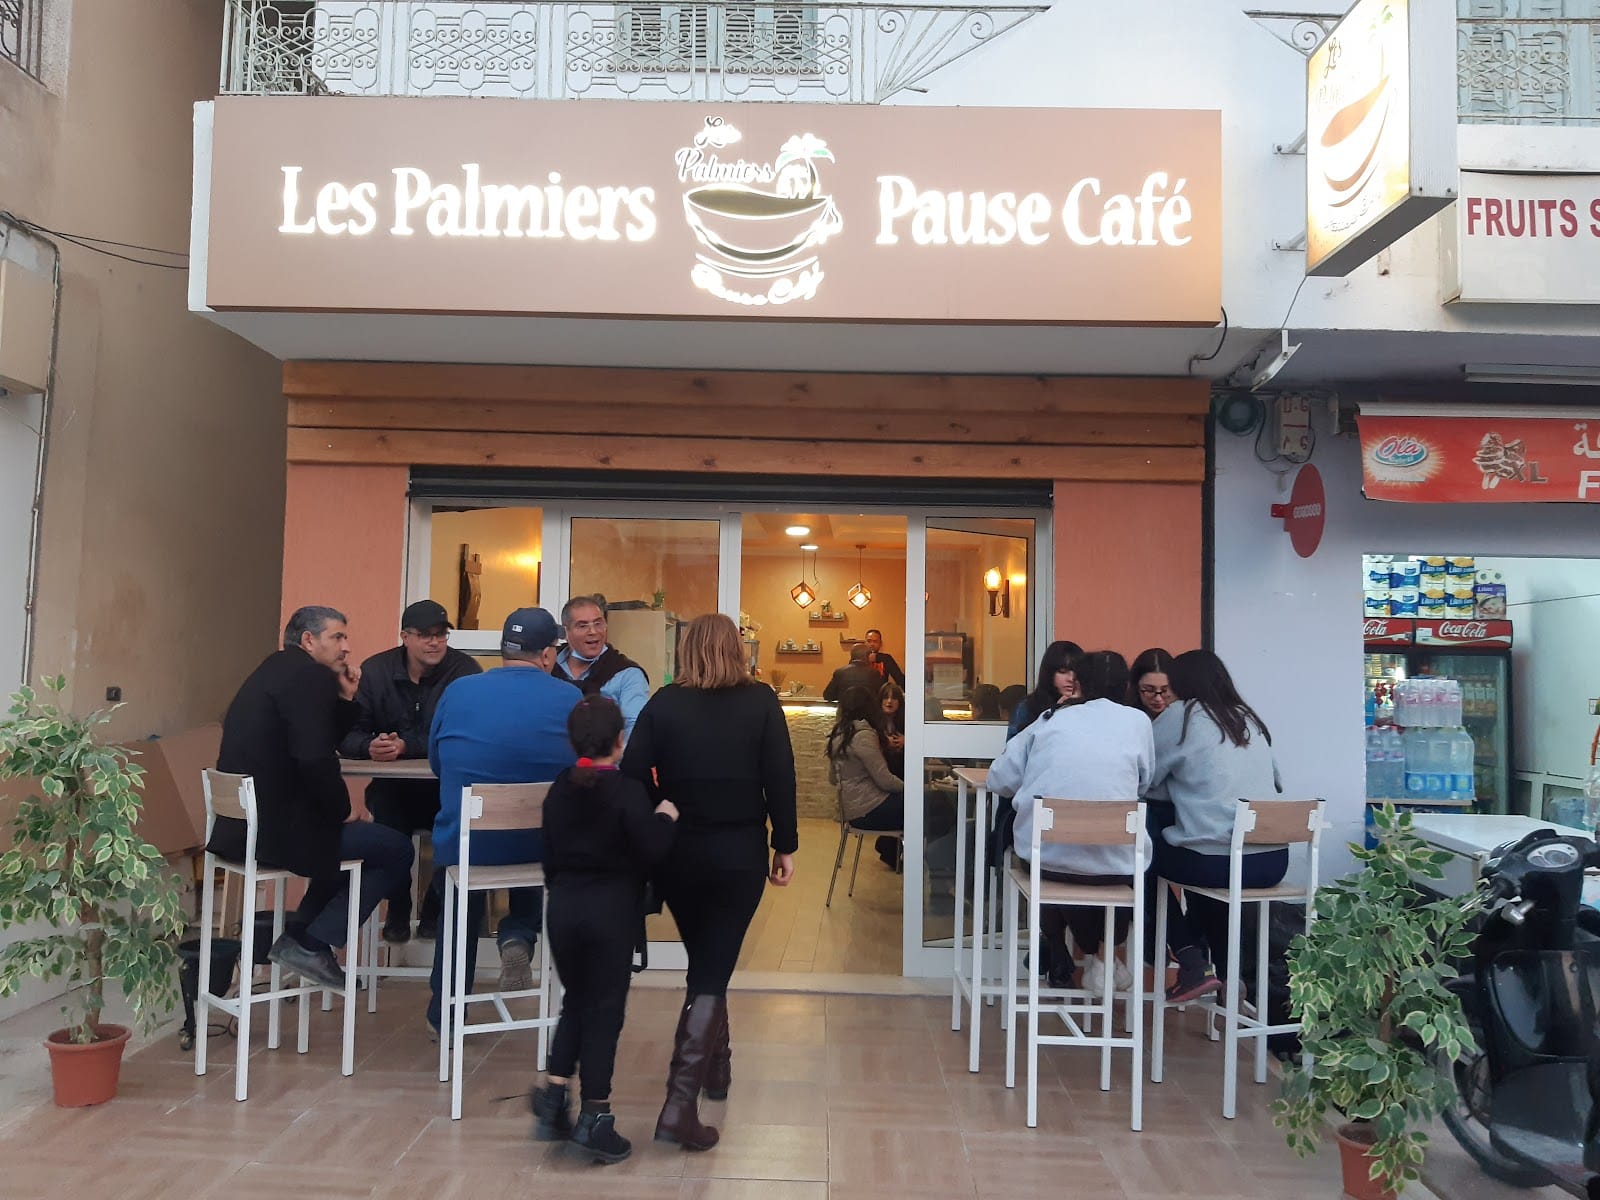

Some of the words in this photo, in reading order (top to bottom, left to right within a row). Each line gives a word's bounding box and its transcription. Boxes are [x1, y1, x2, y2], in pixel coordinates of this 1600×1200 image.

[676, 148, 775, 182] Palmiers
[279, 166, 378, 236] Les
[391, 163, 658, 241] Palmiers
[875, 174, 1051, 246] Pause
[1063, 172, 1193, 246] Café
[1467, 197, 1578, 238] FRUITS
[1380, 436, 1419, 458] Ola
[1438, 621, 1487, 638] Coca-Cola
